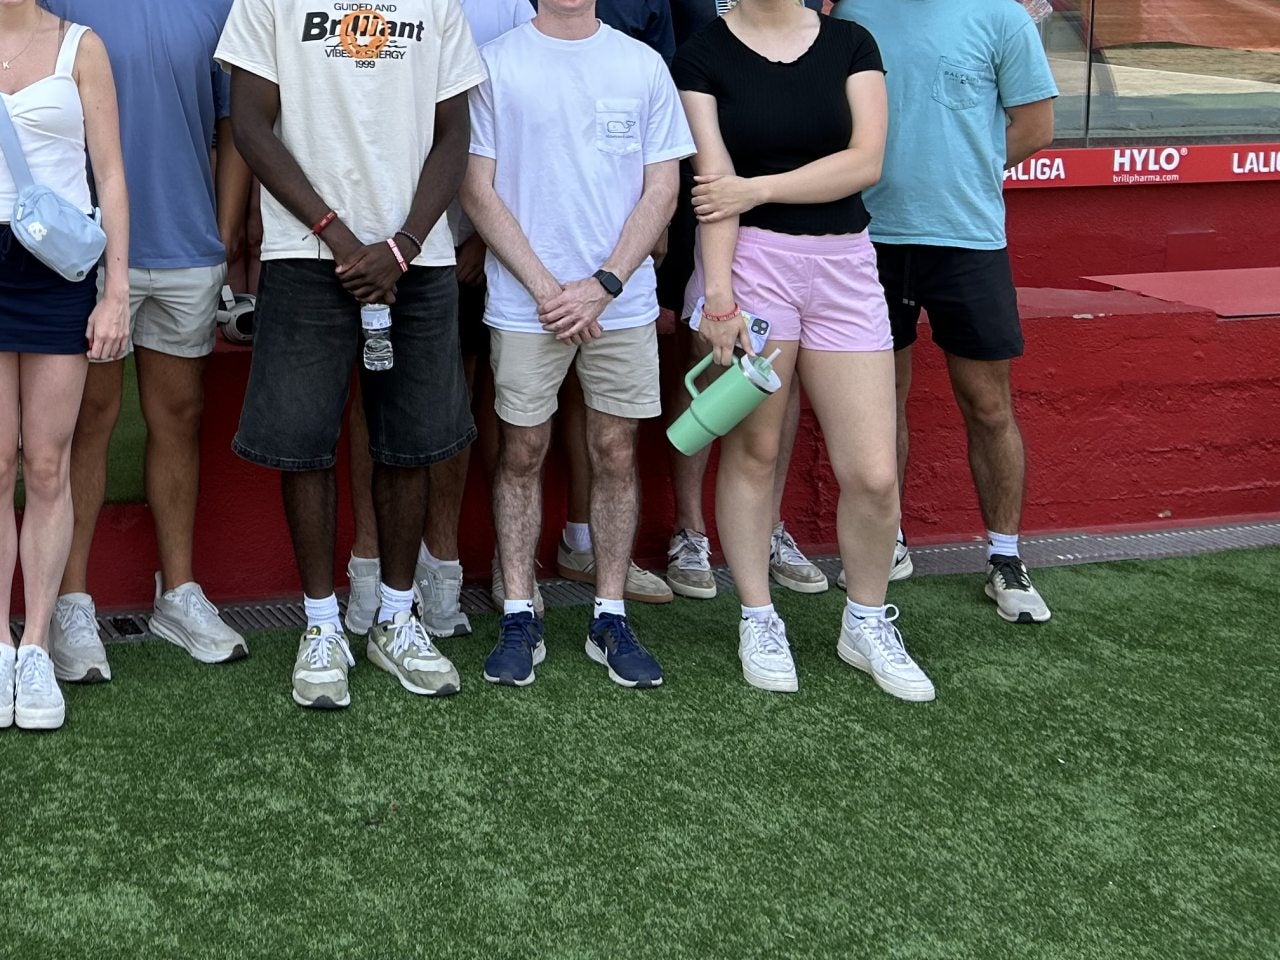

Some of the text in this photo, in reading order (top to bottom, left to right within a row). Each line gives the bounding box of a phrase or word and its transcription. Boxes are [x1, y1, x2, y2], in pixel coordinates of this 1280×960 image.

[333, 2, 397, 13] GUIDED AND
[354, 60, 376, 69] 1999
[1003, 157, 1066, 181] ALIGA
[1112, 174, 1180, 183] brillpharma.com
